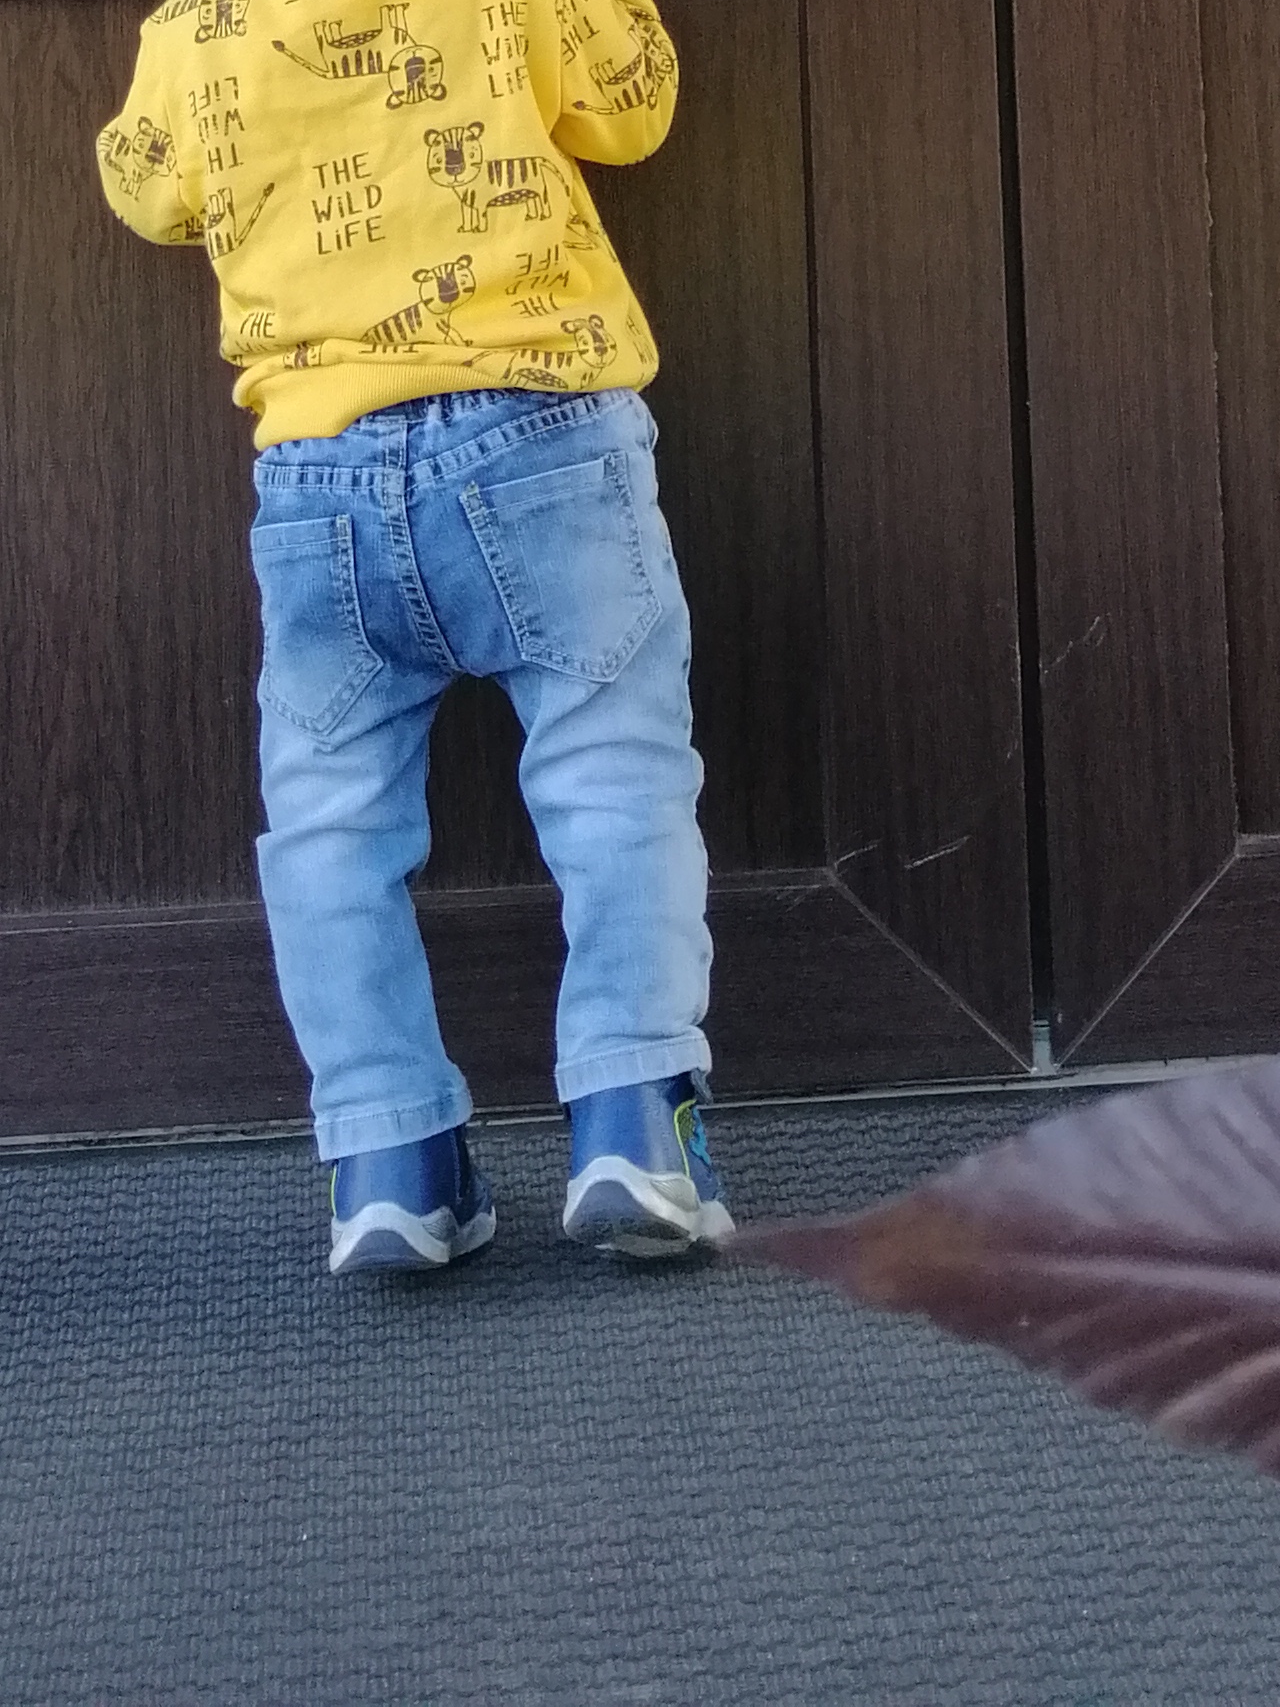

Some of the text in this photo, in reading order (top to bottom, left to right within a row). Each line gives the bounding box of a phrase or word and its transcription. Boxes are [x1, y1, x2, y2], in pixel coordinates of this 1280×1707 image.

[481, 0, 528, 32] THE
[487, 64, 529, 99] LiF
[207, 141, 244, 174] TH
[312, 151, 373, 189] THE
